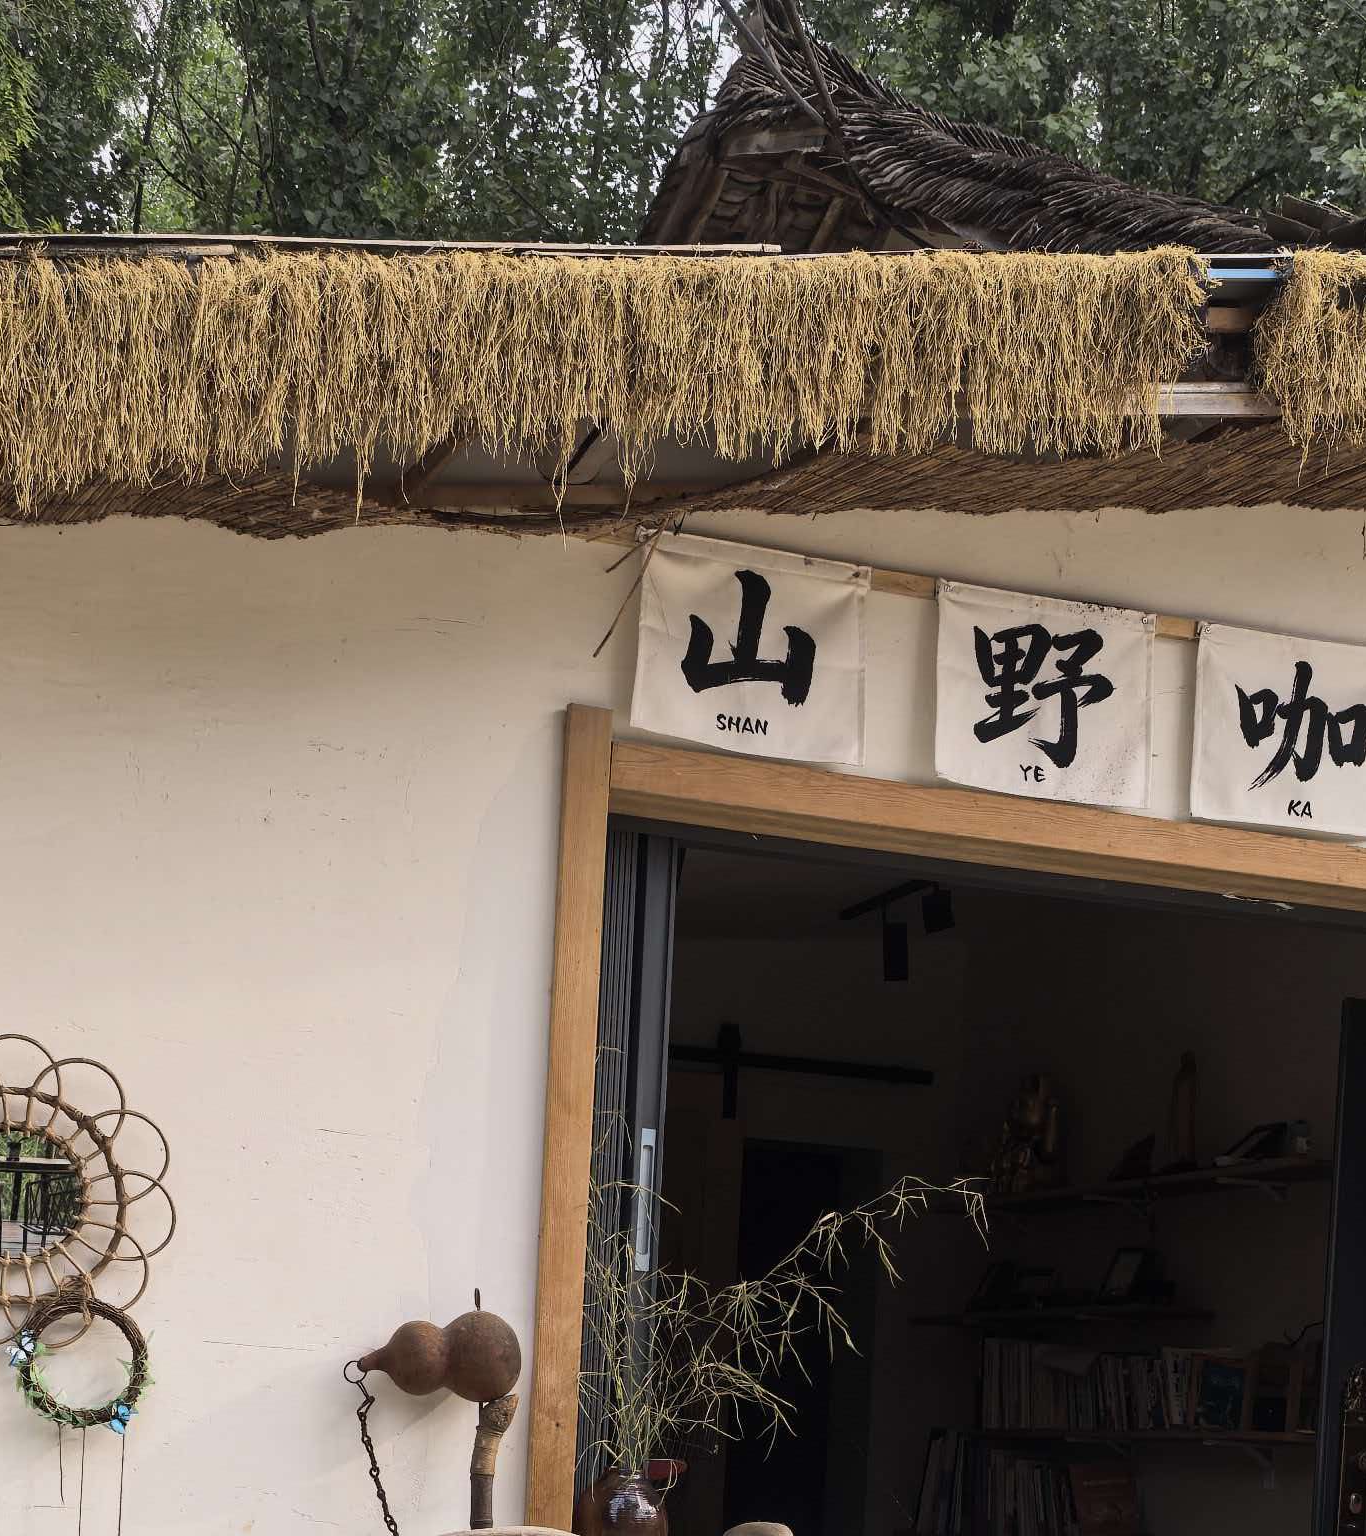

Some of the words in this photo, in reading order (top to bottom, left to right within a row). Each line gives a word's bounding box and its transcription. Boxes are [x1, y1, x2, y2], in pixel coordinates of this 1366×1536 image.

[681, 569, 817, 707] 山
[973, 622, 1117, 769] 野
[716, 713, 769, 736] SHAN
[1019, 764, 1046, 783] YE
[1287, 799, 1313, 819] KA
